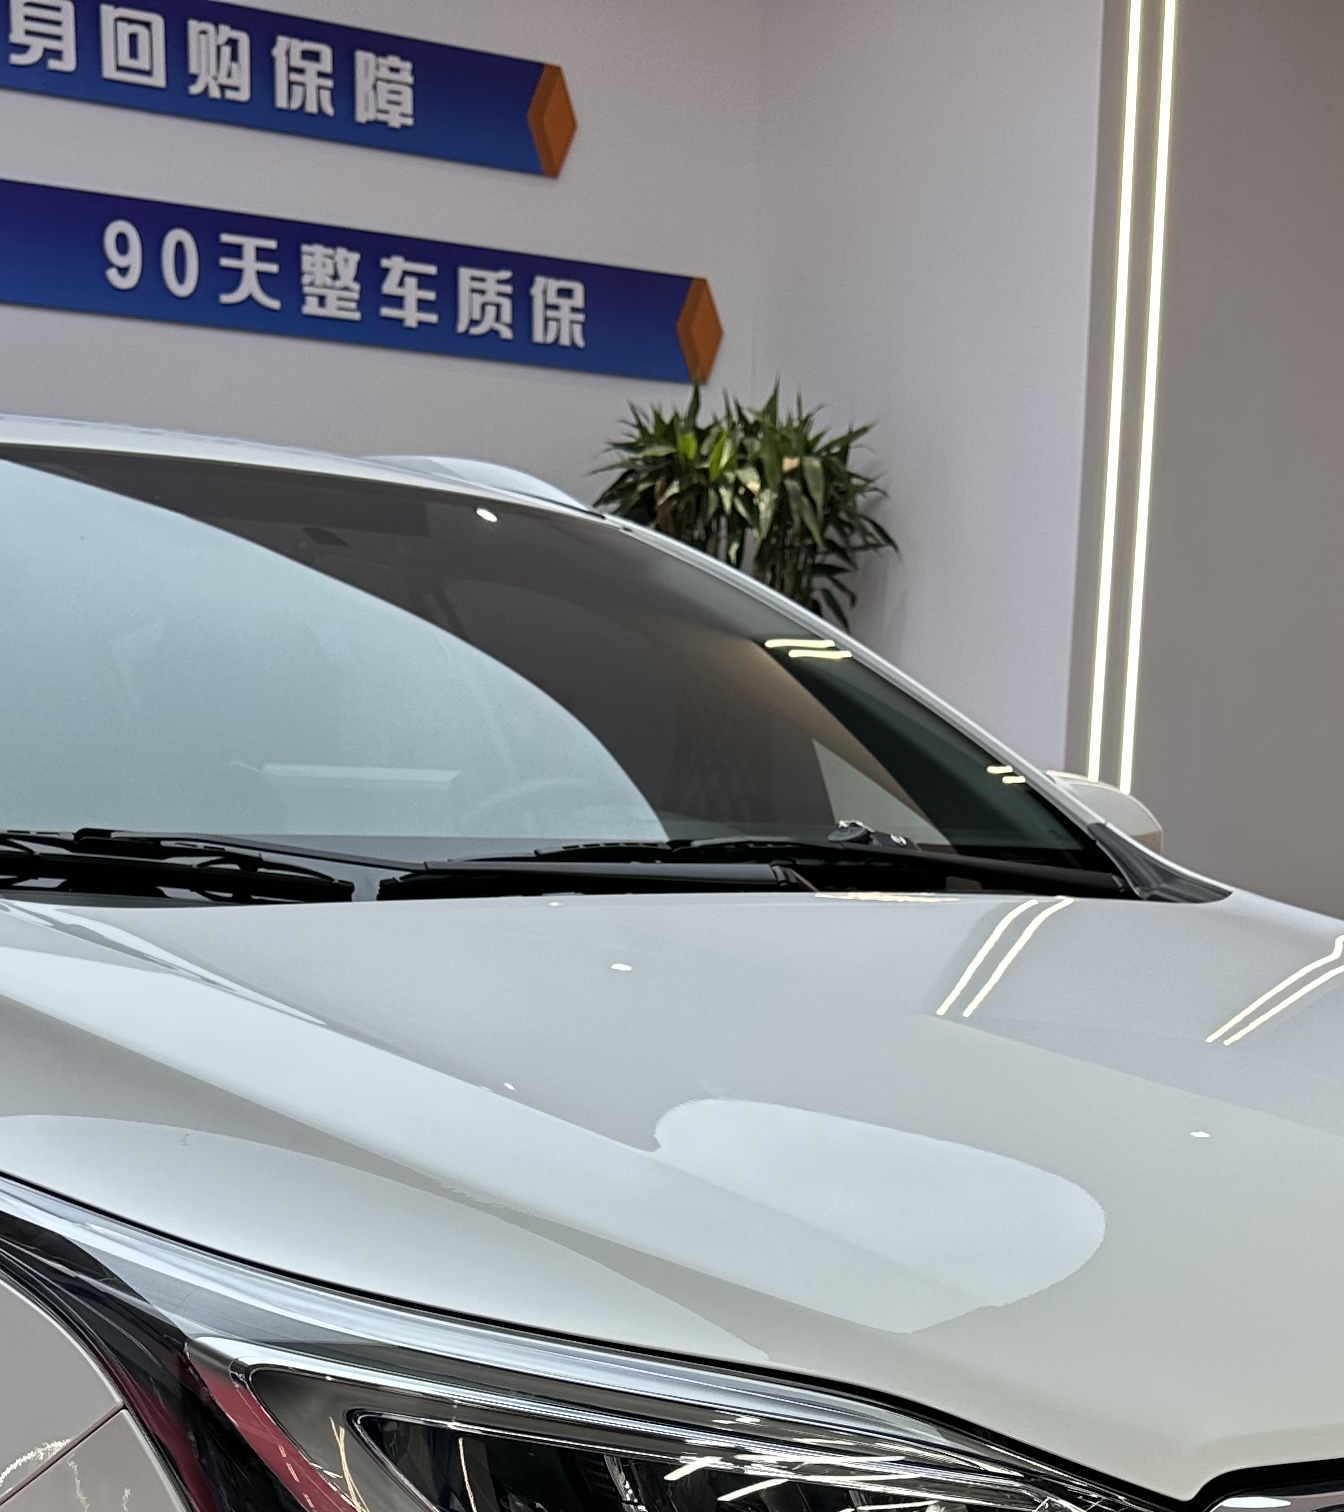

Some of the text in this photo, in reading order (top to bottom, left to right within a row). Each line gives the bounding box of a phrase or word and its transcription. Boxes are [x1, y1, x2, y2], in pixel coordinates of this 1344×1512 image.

[102, 218, 587, 349] 90天整车质保
